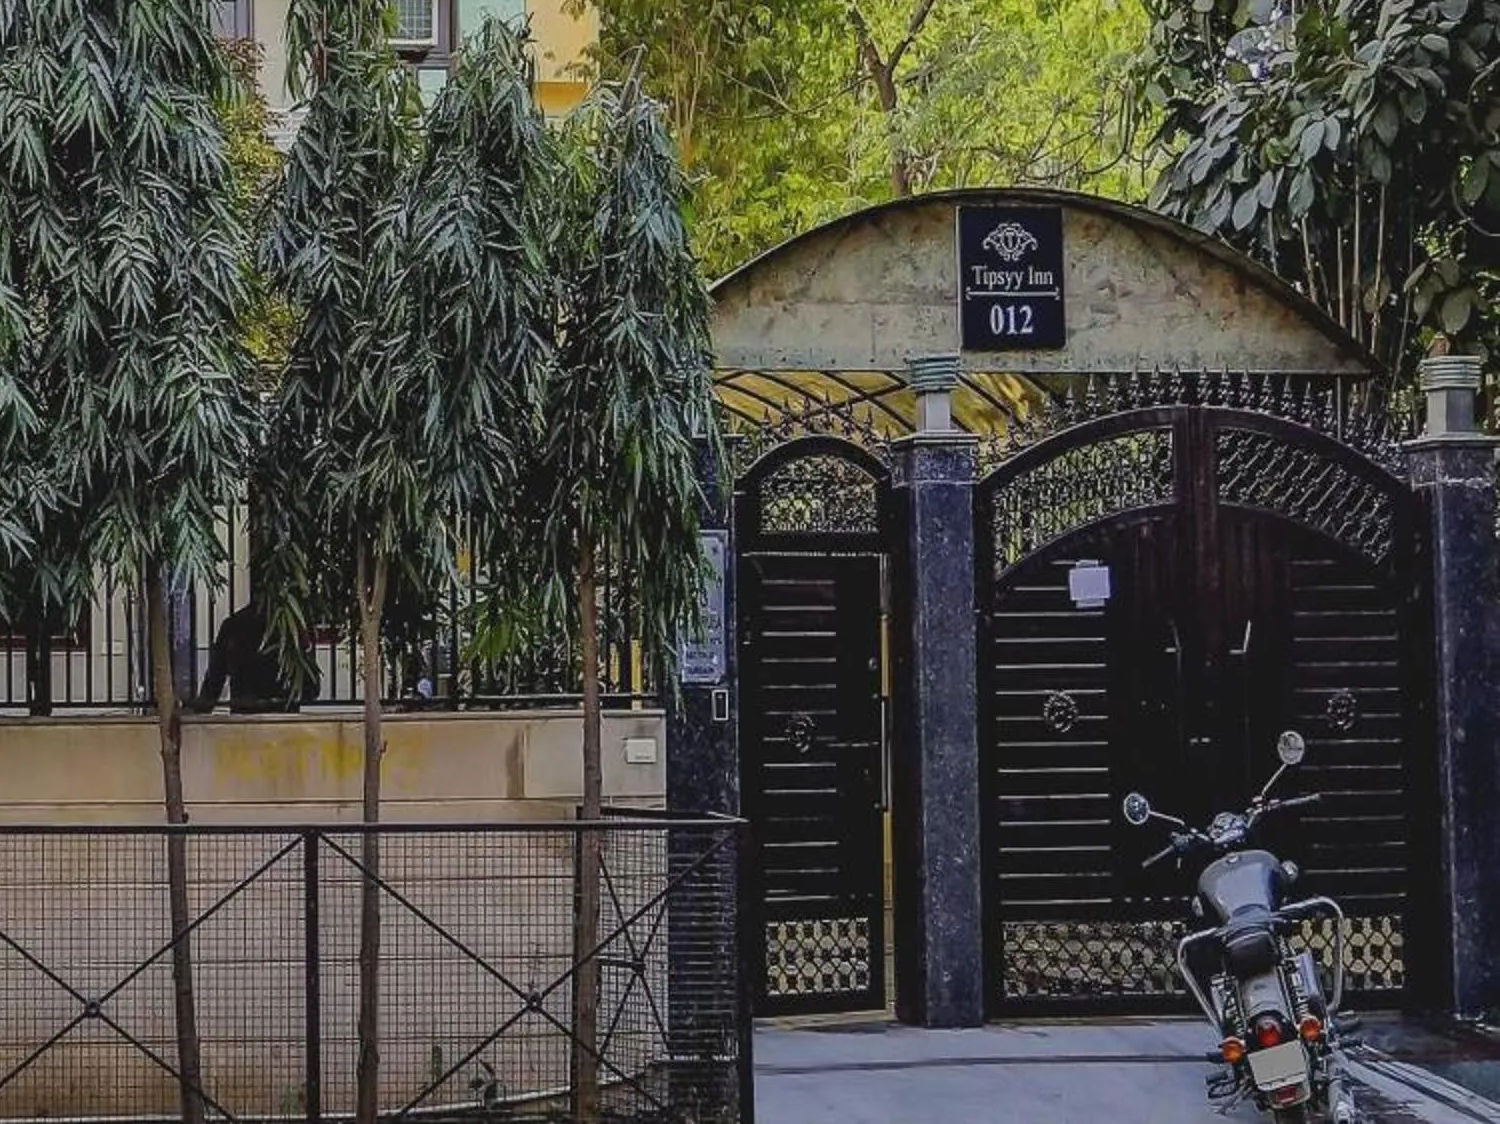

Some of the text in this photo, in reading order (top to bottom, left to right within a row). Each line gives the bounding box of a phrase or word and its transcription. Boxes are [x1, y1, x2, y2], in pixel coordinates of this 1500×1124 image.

[971, 265, 1054, 290] Tipsyy Inn
[990, 304, 1034, 335] 012
